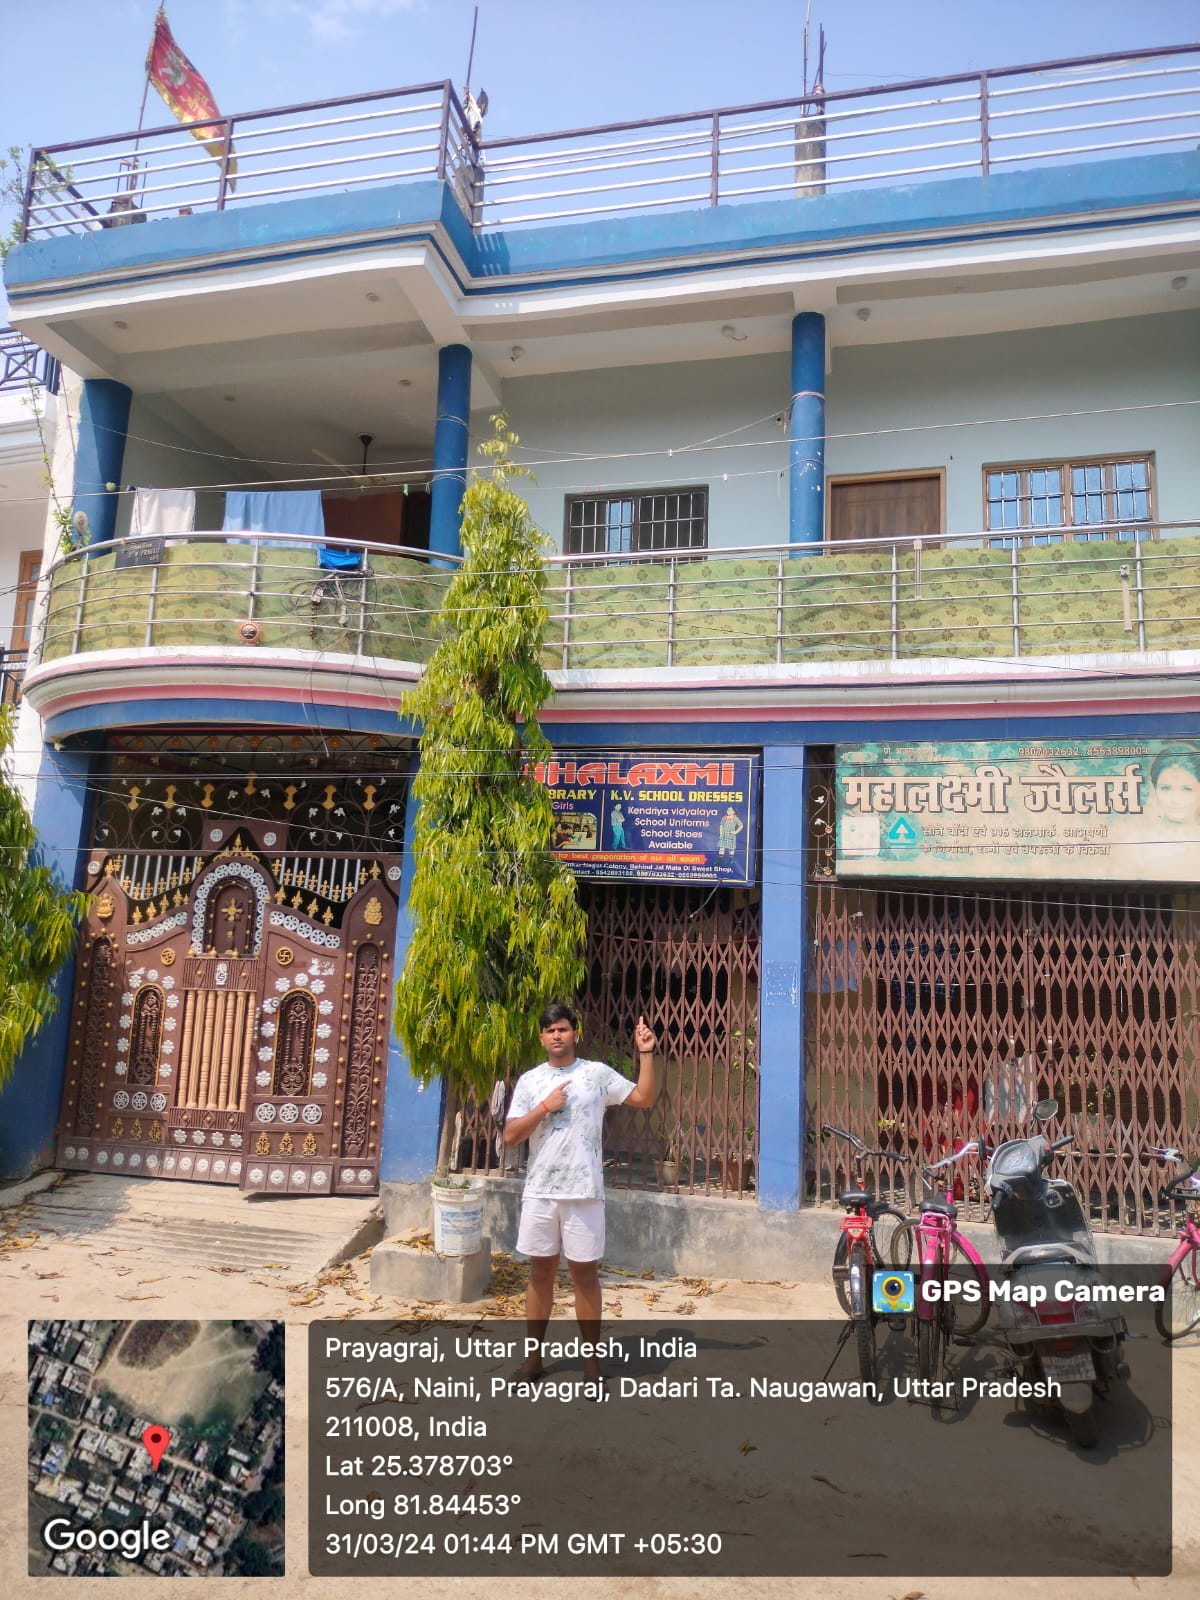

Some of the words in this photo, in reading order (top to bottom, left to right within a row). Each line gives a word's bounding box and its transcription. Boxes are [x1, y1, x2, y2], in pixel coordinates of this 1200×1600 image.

[610, 790, 635, 801] K.V.
[638, 791, 686, 801] SCHOOL
[688, 791, 744, 802] DRESSES
[551, 801, 574, 810] Girls
[627, 806, 669, 816] Kendriya
[634, 817, 667, 826] School
[669, 818, 711, 827] Uniforms
[640, 829, 673, 838] School
[674, 830, 704, 839] Shoes
[648, 841, 694, 849] Available
